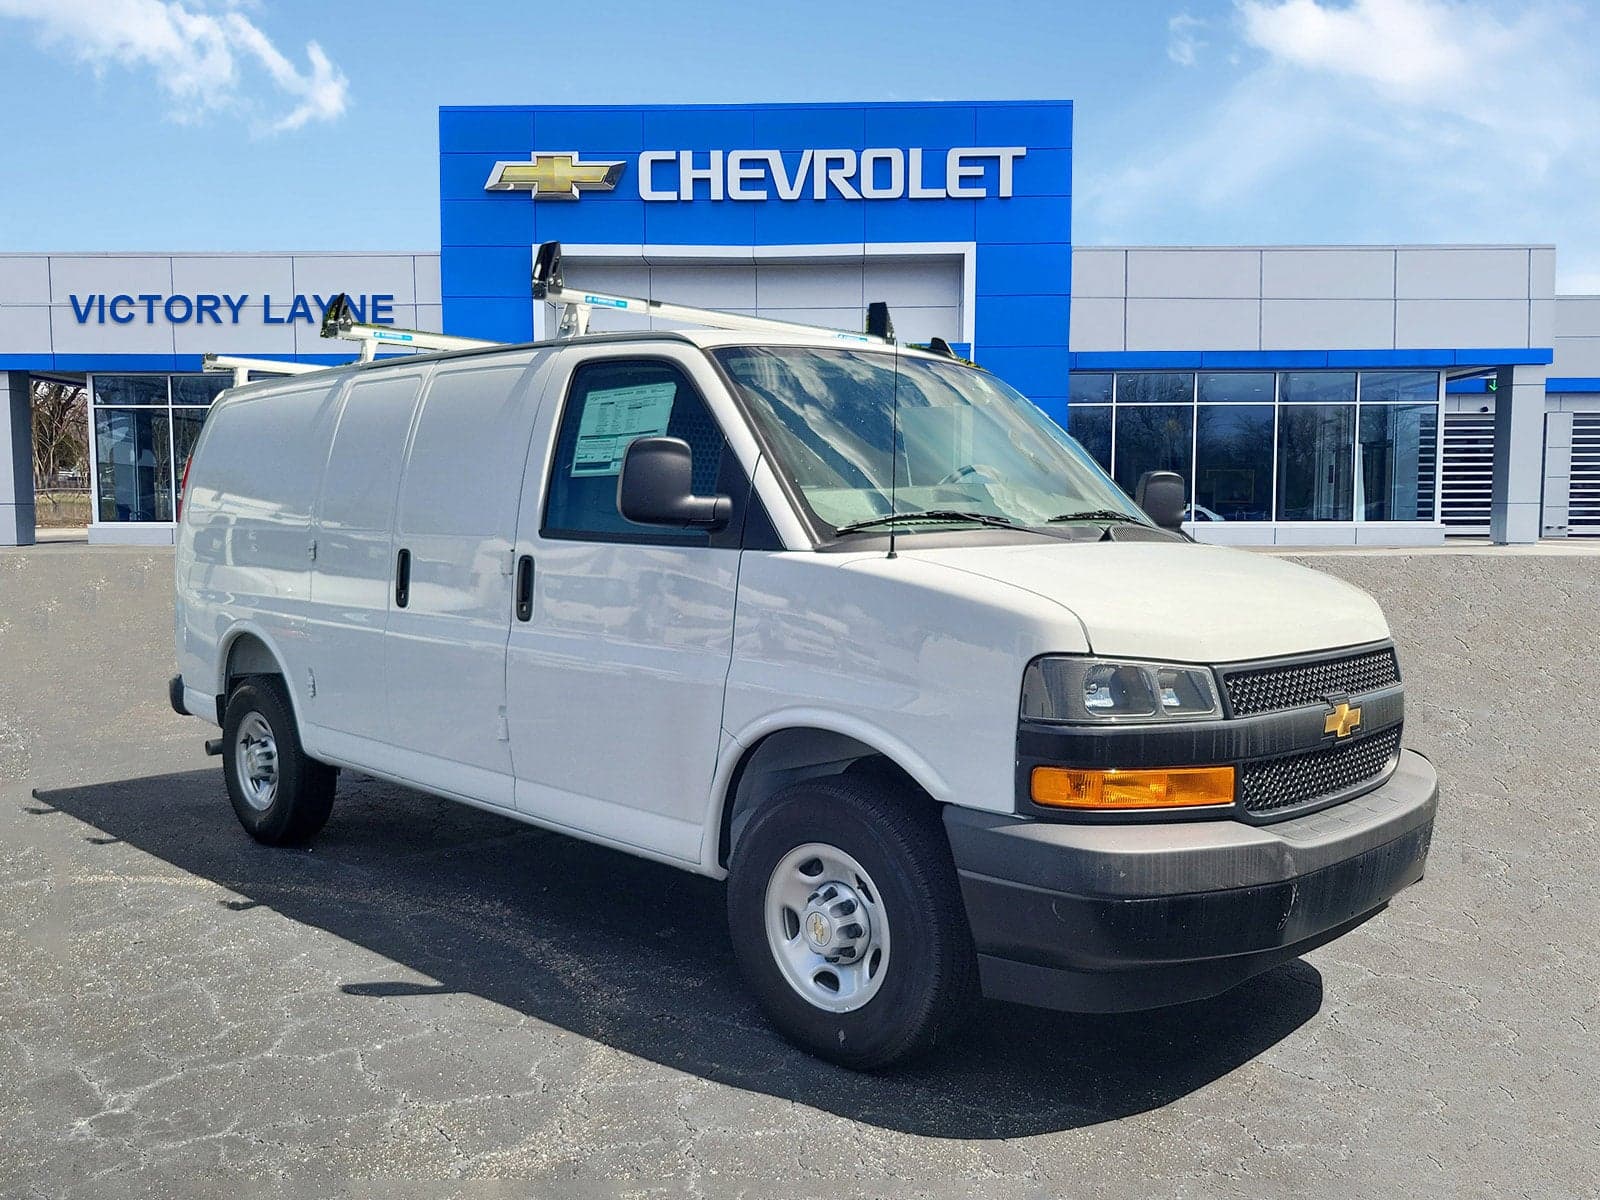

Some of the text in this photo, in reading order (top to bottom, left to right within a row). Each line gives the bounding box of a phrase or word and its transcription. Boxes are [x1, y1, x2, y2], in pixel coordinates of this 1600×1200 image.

[638, 146, 1027, 201] CHEVROLET
[69, 294, 395, 324] VICTORY LAYNE
